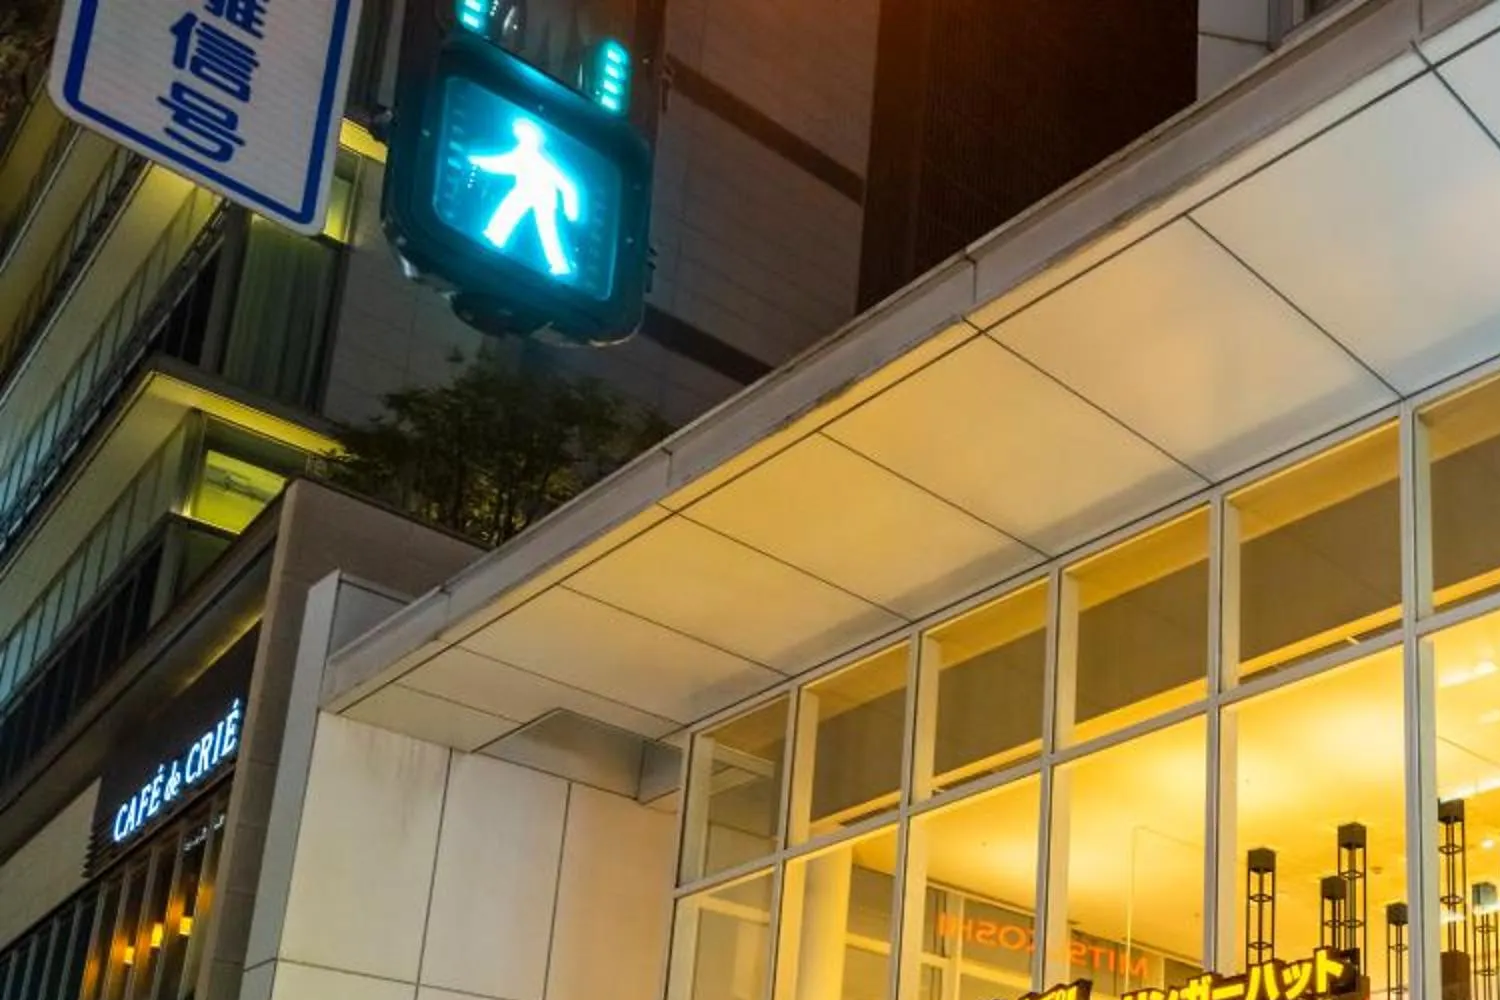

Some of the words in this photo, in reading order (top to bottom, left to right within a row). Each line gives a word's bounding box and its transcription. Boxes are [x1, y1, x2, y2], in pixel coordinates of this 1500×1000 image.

[113, 763, 164, 841] CAFÉ
[164, 760, 181, 801] de
[185, 697, 240, 784] CRIÉ
